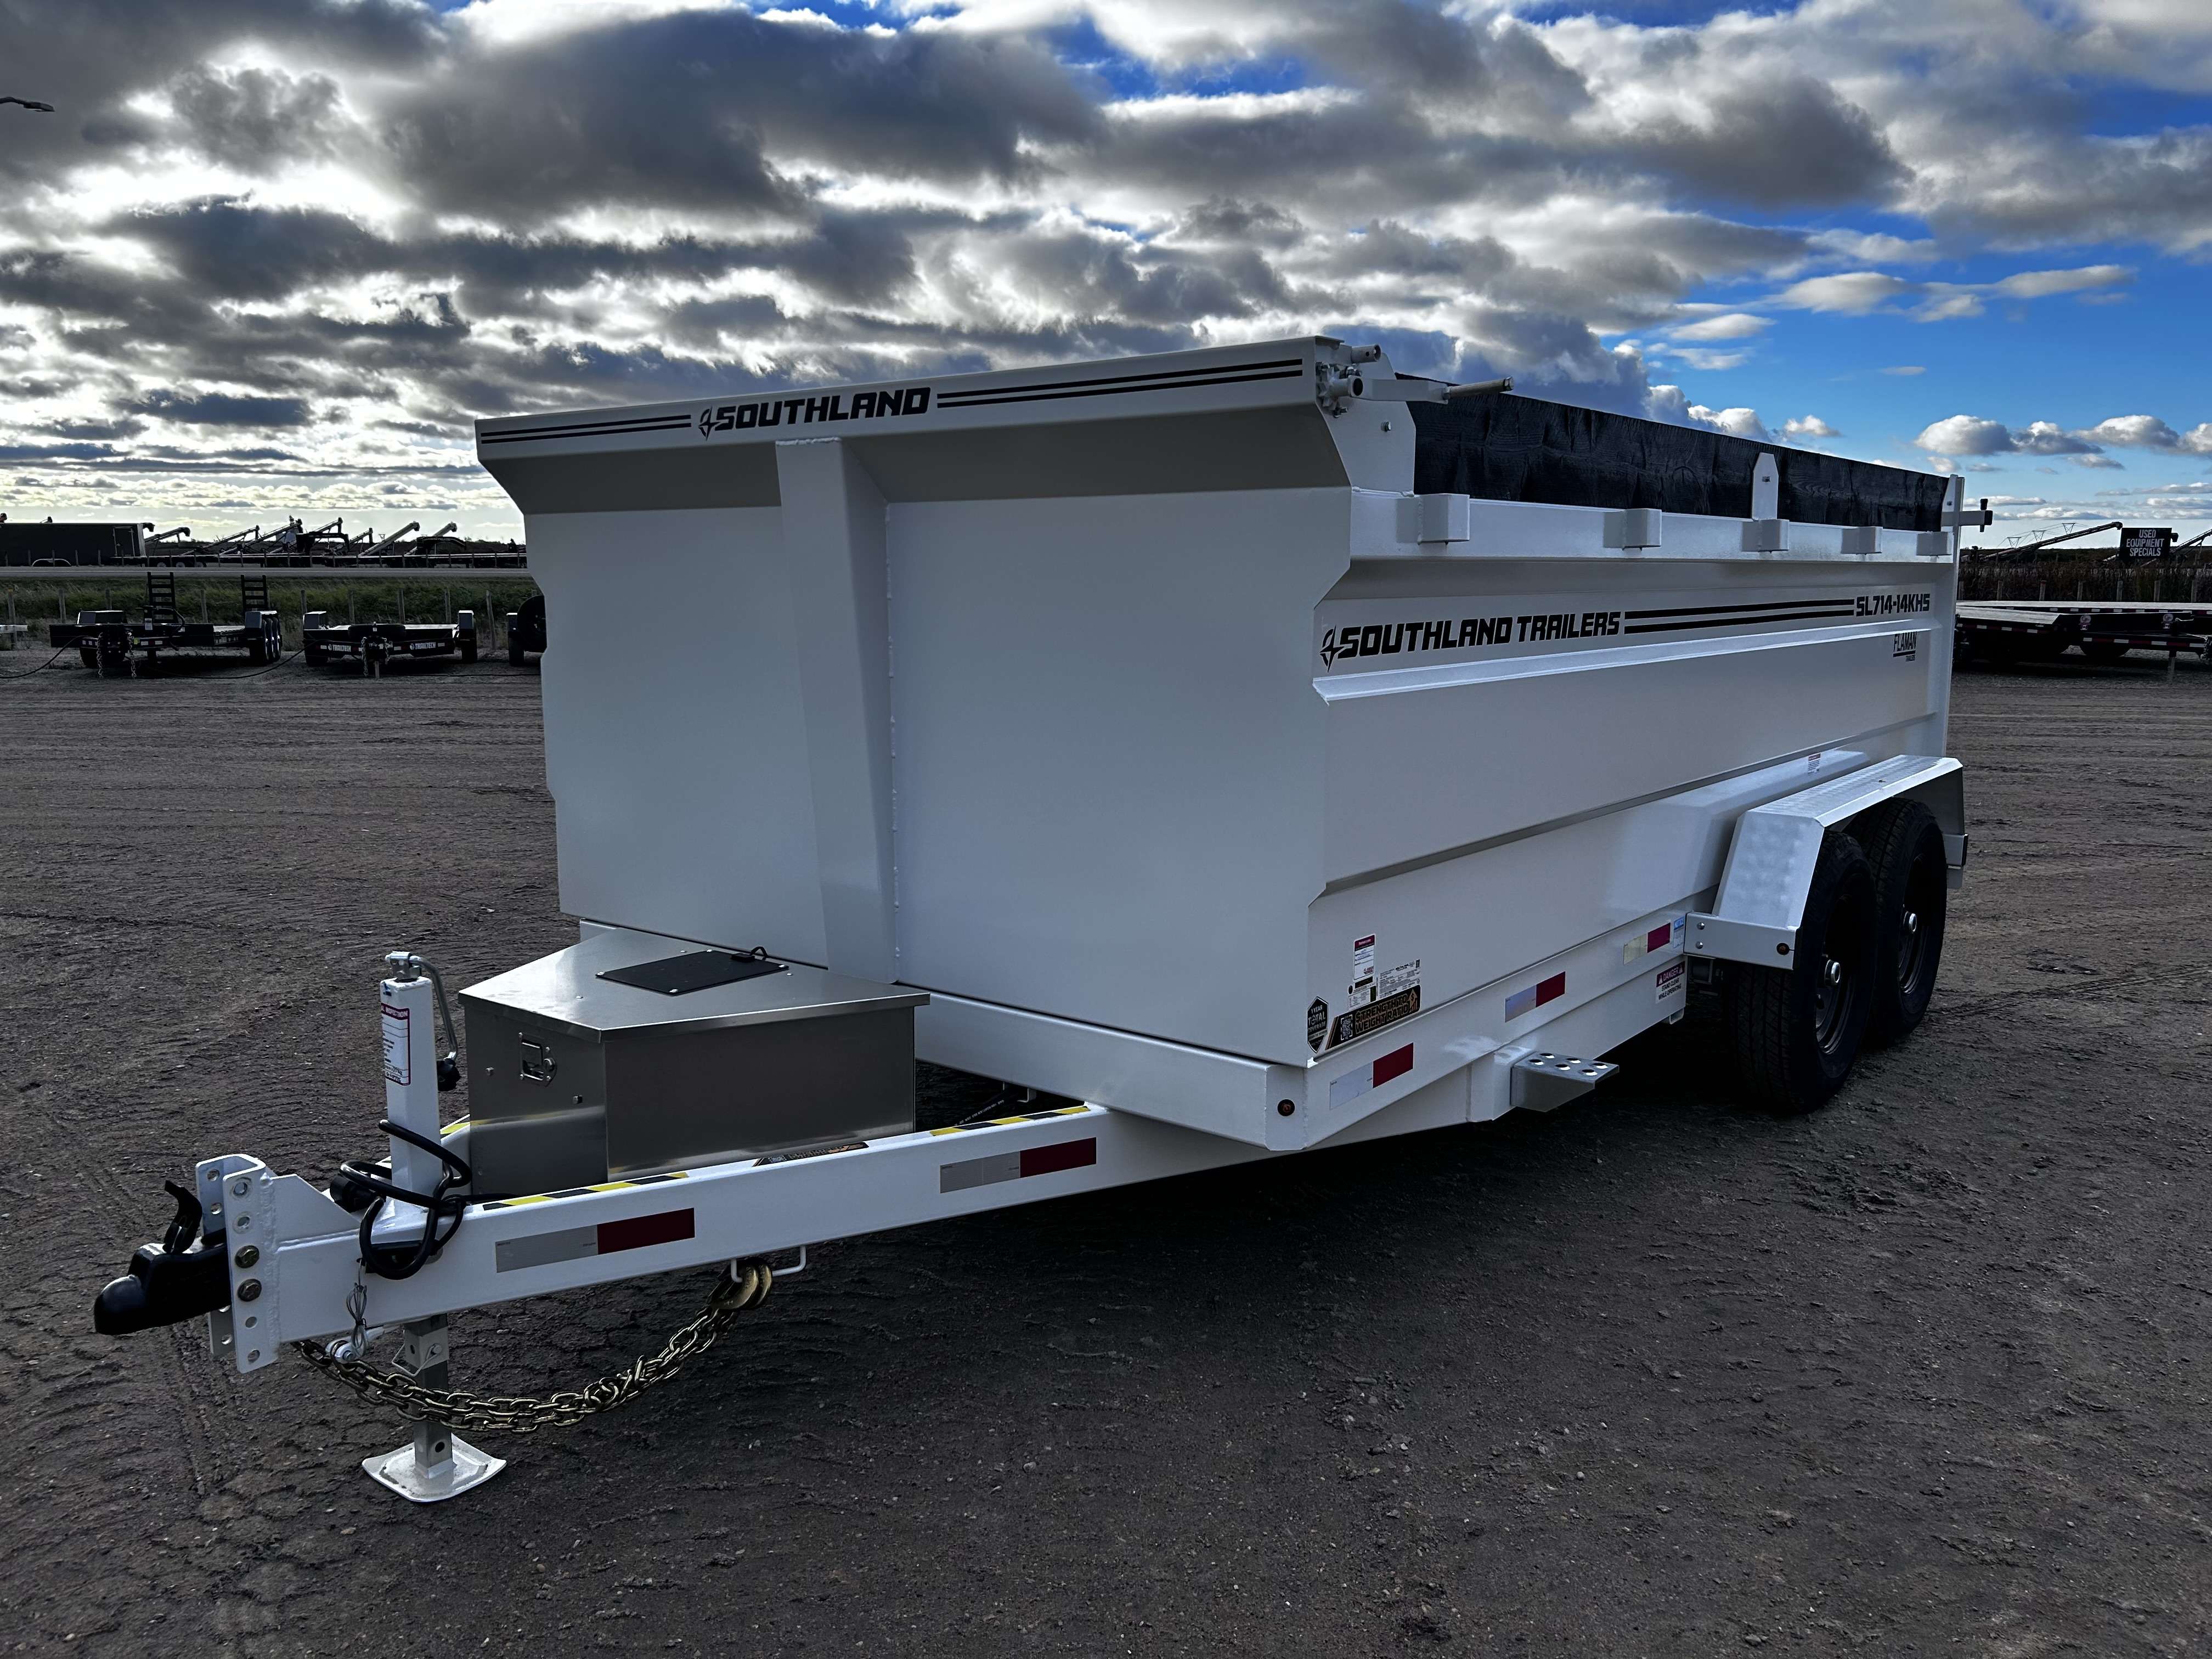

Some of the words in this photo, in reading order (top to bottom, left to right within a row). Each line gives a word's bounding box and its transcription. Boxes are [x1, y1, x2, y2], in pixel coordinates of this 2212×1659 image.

[714, 387, 931, 431] SOUTHLAND
[2126, 539, 2165, 548] EQUIPMENT
[2139, 529, 2157, 538] USED
[2129, 548, 2162, 556] SPECIALS
[1856, 594, 1931, 617] SL714-14KHS
[1337, 617, 1513, 659] SOUTHLAND
[1516, 611, 1621, 642] TRAILERS
[1893, 631, 1917, 652] FLAMAN
[1663, 967, 1678, 980] DANGER
[1355, 998, 1396, 1020] STRENGTH
[1395, 994, 1408, 1006] TO
[1308, 1011, 1326, 1026] TOTAL
[1355, 1011, 1387, 1034] WEIGHT
[1386, 1002, 1409, 1022] RATIO
